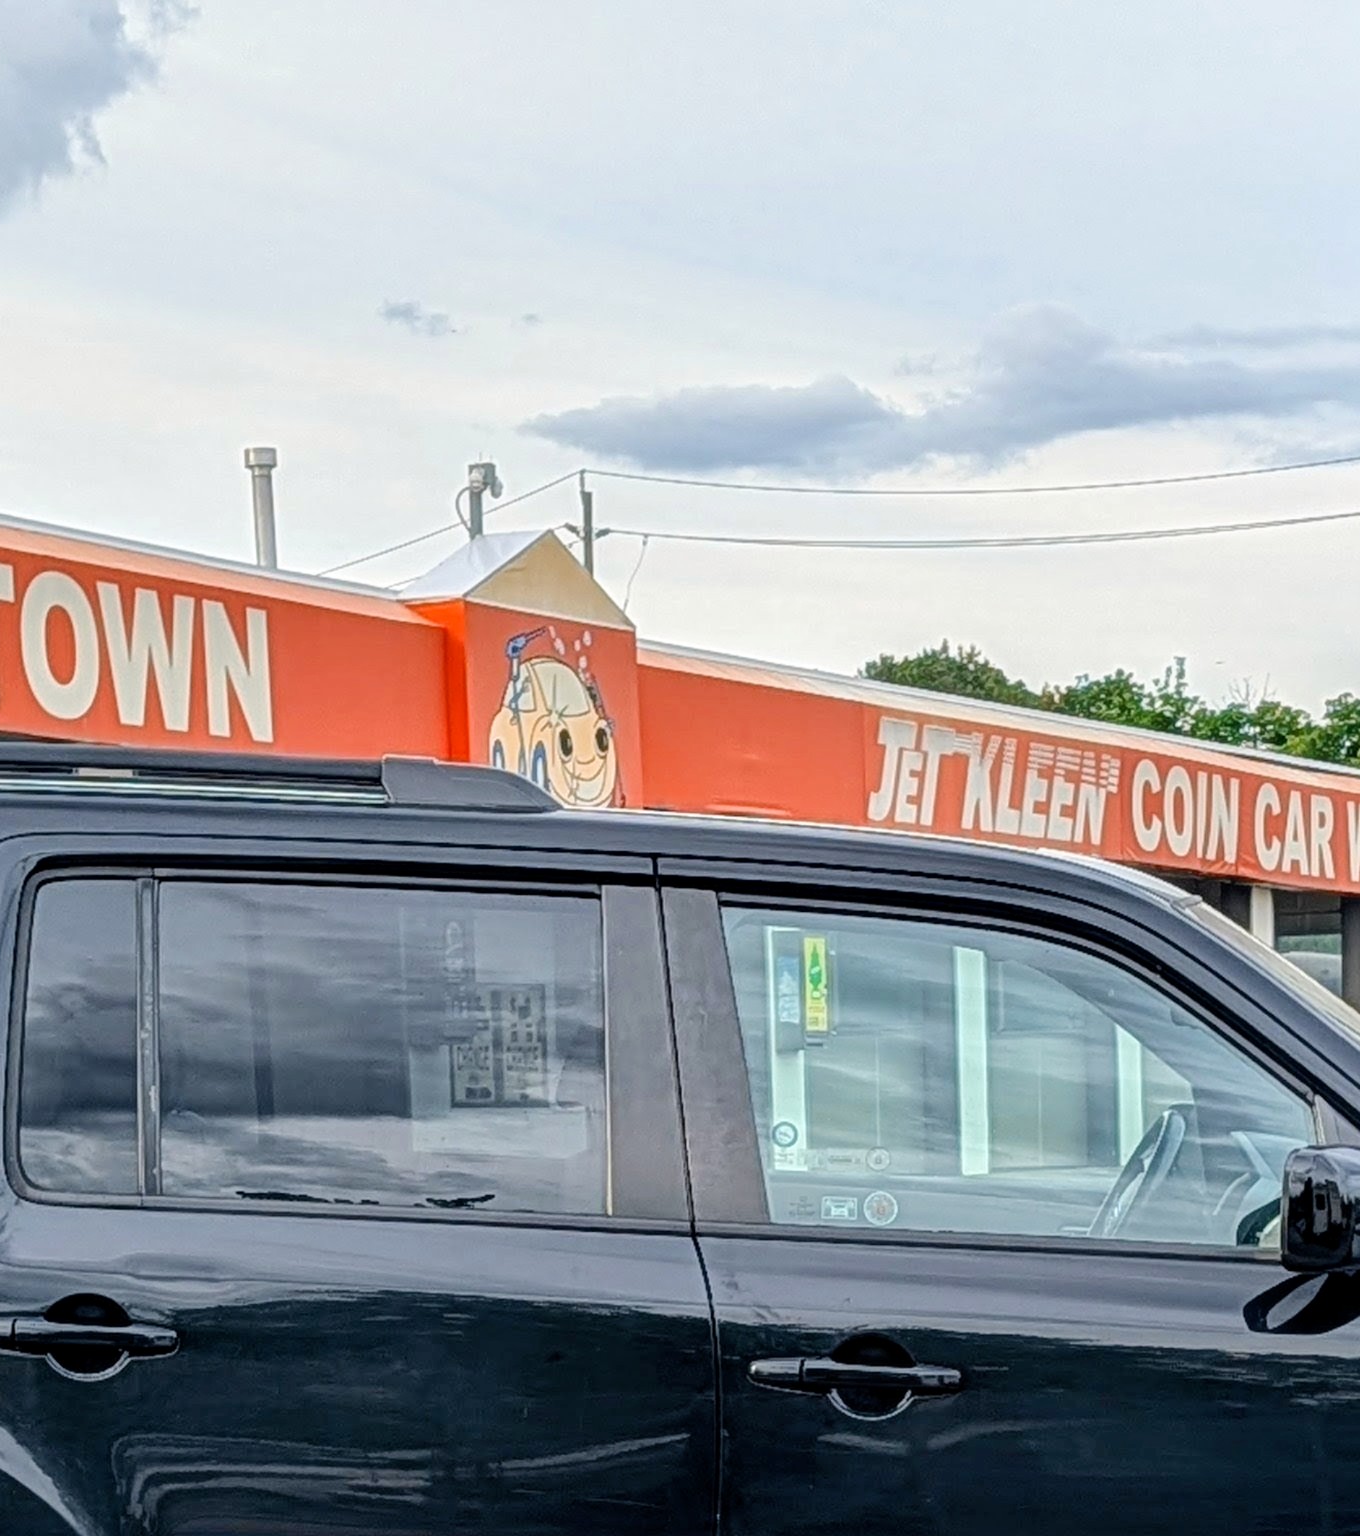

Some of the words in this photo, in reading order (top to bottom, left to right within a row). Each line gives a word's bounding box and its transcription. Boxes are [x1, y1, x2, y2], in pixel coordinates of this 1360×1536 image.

[868, 716, 955, 826] JET
[961, 732, 1121, 846] KLEEN
[1131, 758, 1240, 864] COIN
[1254, 782, 1335, 880] CAR
